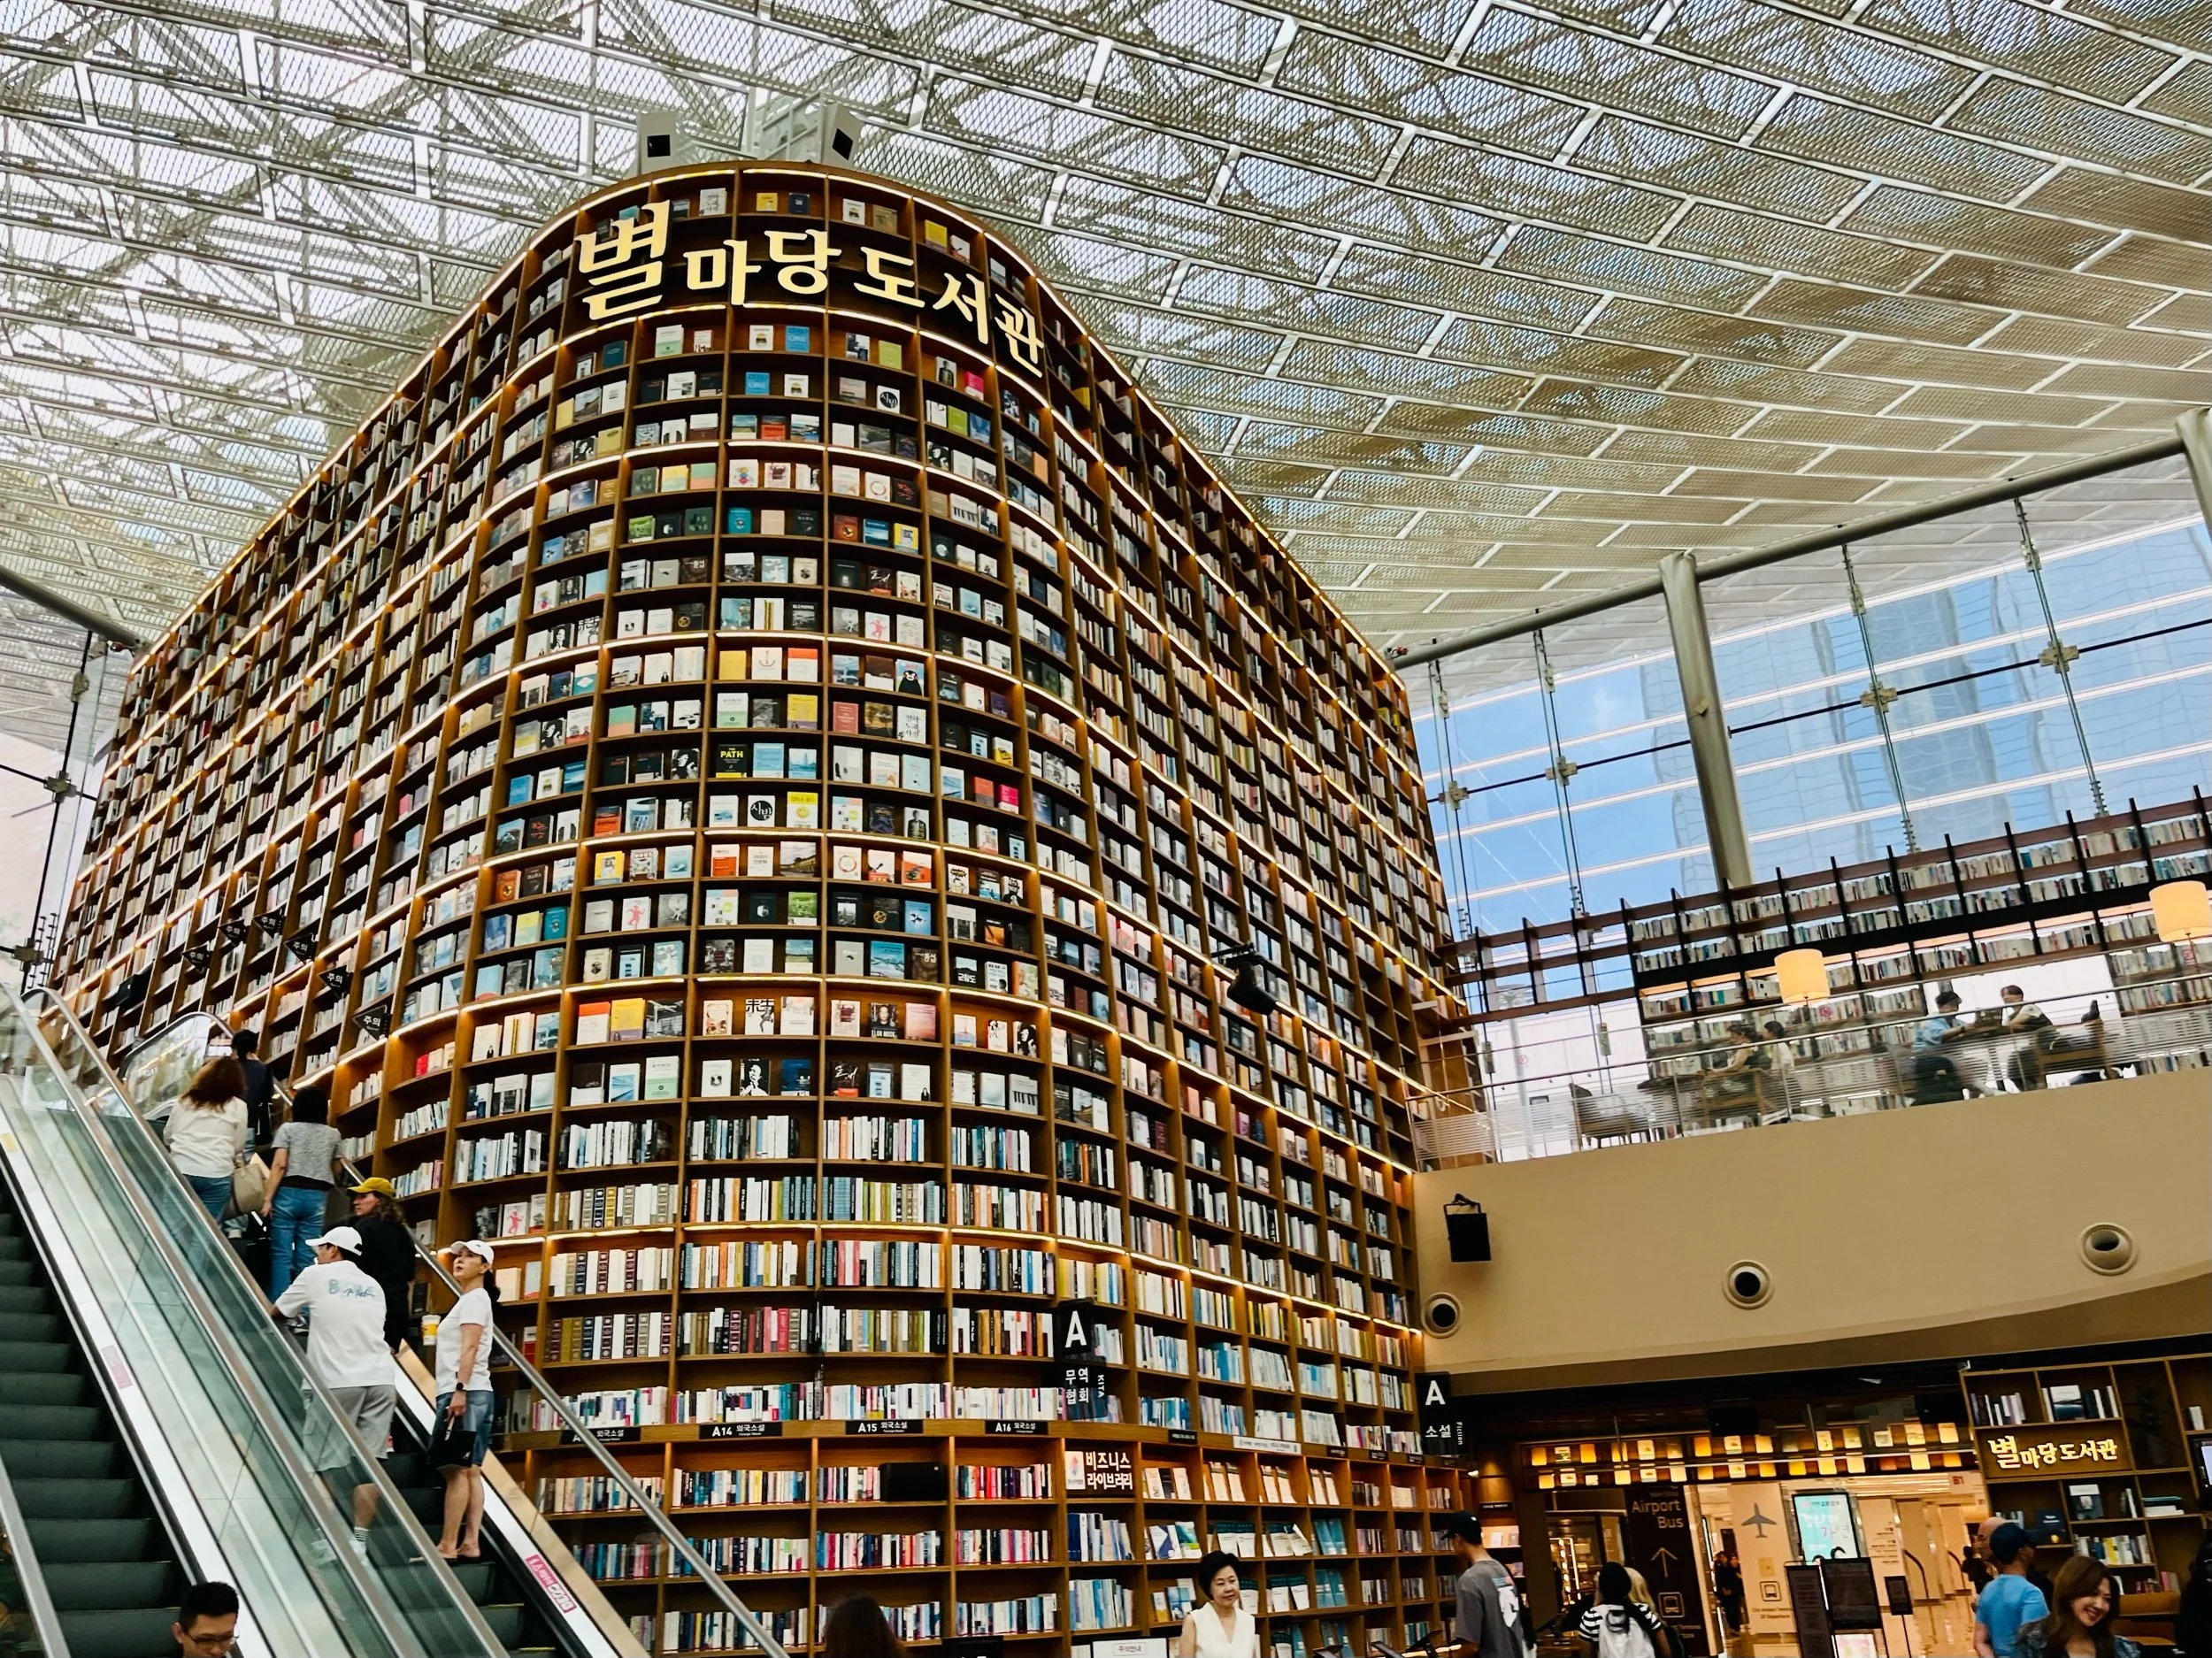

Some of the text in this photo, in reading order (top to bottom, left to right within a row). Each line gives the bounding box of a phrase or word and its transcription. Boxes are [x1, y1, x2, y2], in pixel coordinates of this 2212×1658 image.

[327, 972, 343, 984] 주의
[364, 1015, 380, 1027] 주의
[1065, 1310, 1087, 1348] A
[1425, 1379, 1446, 1406] A
[711, 1426, 733, 1437] A14
[736, 1424, 765, 1432] 외국소설
[857, 1422, 878, 1432] A15
[880, 1421, 907, 1430] 외국소설
[995, 1422, 1011, 1432] A16
[1425, 1424, 1451, 1439] 소설
[596, 1429, 624, 1438] 외국소설
[1086, 1452, 1131, 1471] 비즈니스
[1087, 1472, 1133, 1490] 라이브러리
[1632, 1501, 1681, 1515] Airport
[1658, 1516, 1684, 1528] Bus
